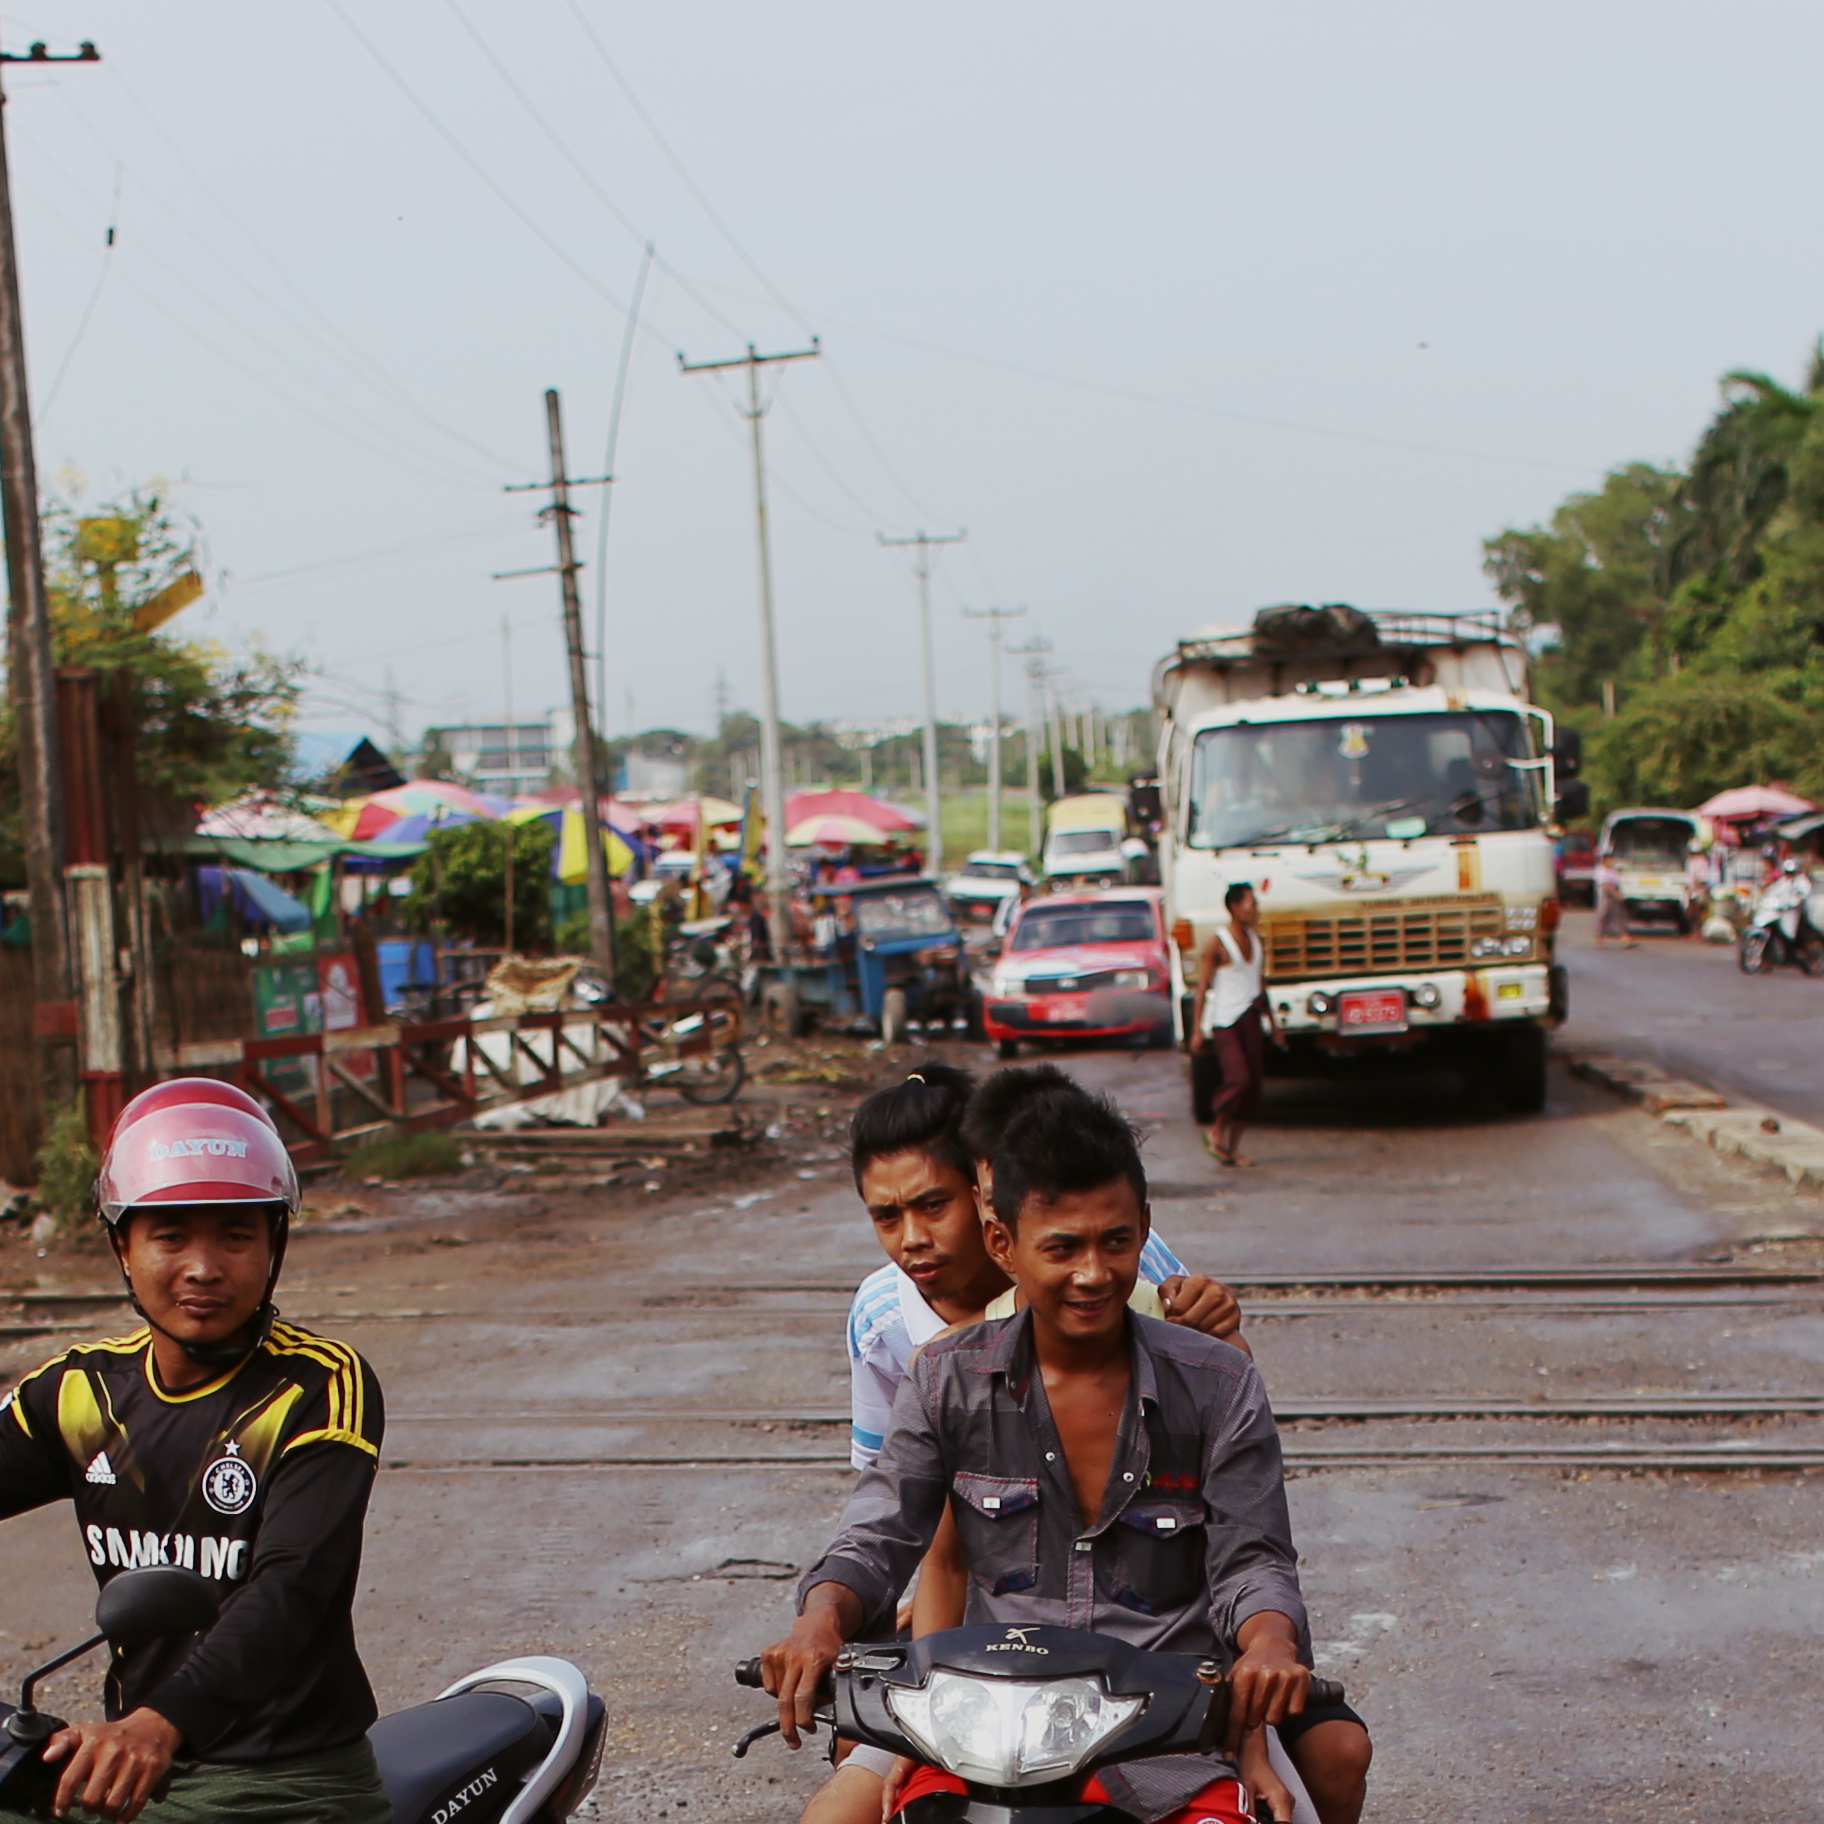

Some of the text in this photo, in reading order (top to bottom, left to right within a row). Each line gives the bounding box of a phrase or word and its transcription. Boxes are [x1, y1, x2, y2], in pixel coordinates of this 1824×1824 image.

[149, 1138, 247, 1161] DAYUN
[215, 1462, 245, 1475] CHELSEA
[985, 1643, 1049, 1655] KENBO
